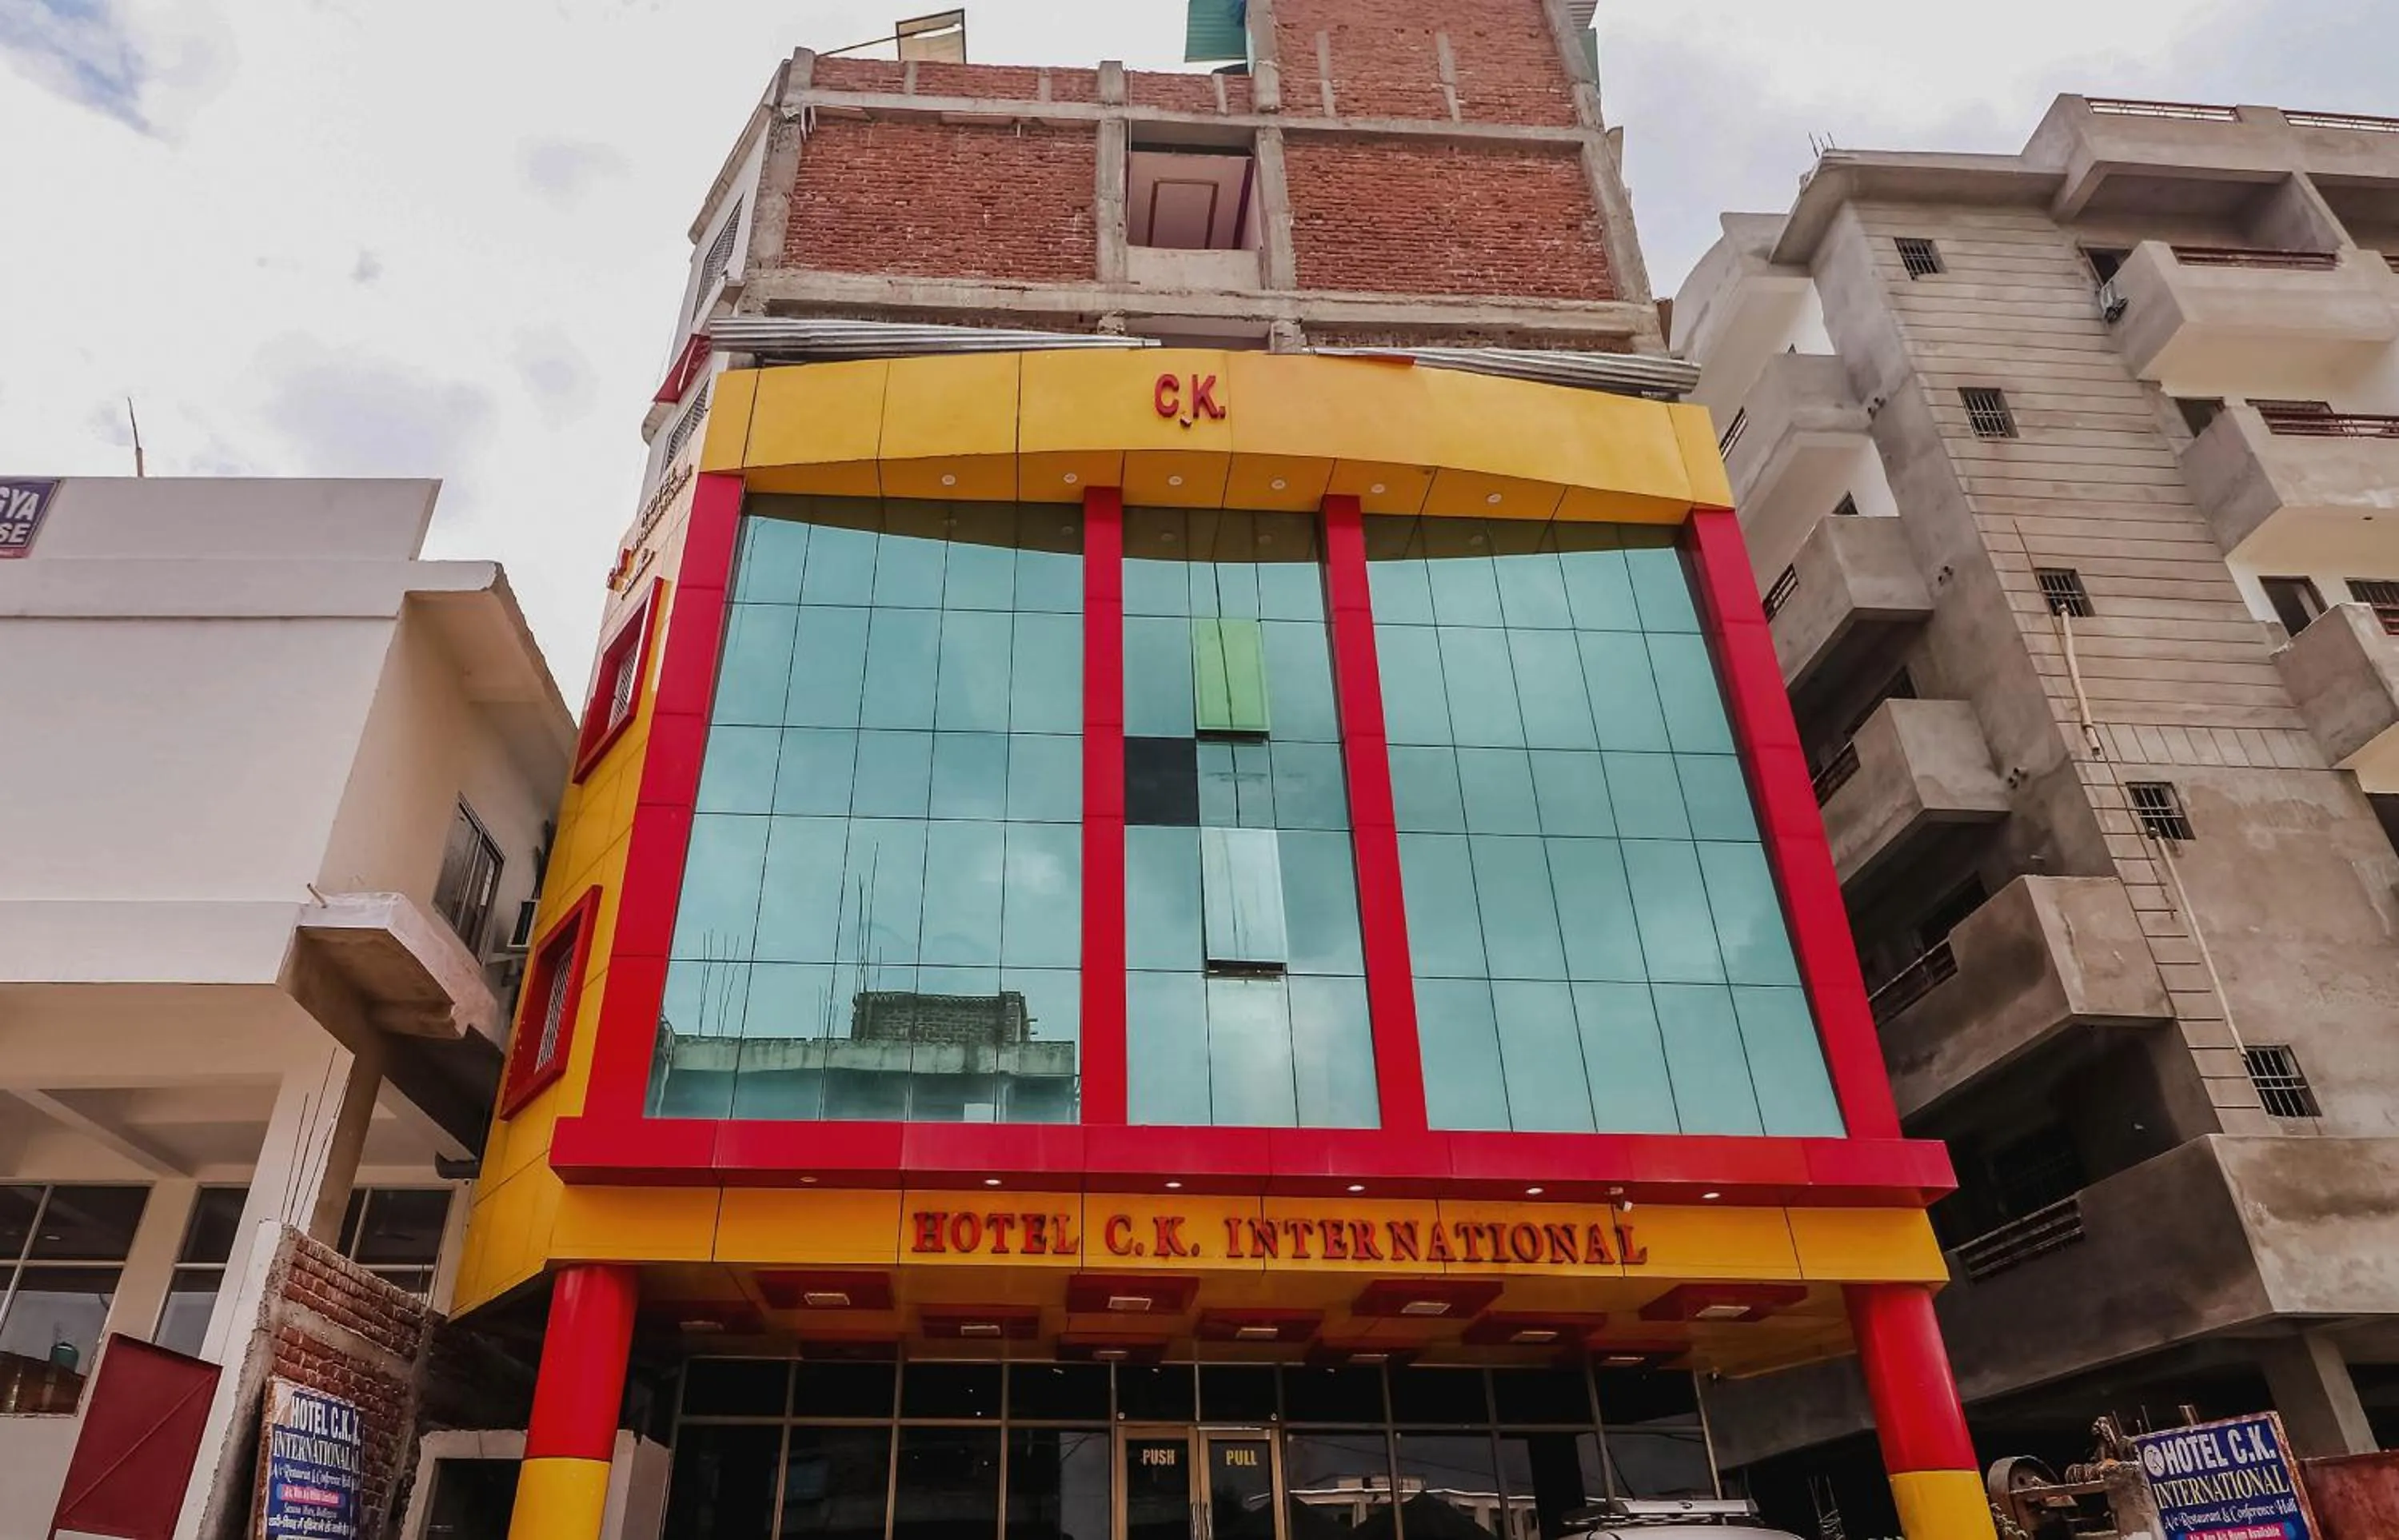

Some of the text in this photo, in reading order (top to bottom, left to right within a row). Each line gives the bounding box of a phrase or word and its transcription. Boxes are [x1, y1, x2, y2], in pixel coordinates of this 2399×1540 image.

[911, 1211, 1648, 1265] HOTEL C.K. INTERNATIONAL
[290, 1395, 329, 1436] HOTEL
[273, 1430, 352, 1471] INTERNATIONAL
[1142, 1449, 1175, 1466] PUSH
[1225, 1450, 1258, 1466] PULL
[2160, 1430, 2229, 1475] HOTEL
[2227, 1425, 2277, 1464] C.K.
[2151, 1464, 2290, 1510] INTERNATIONAL
